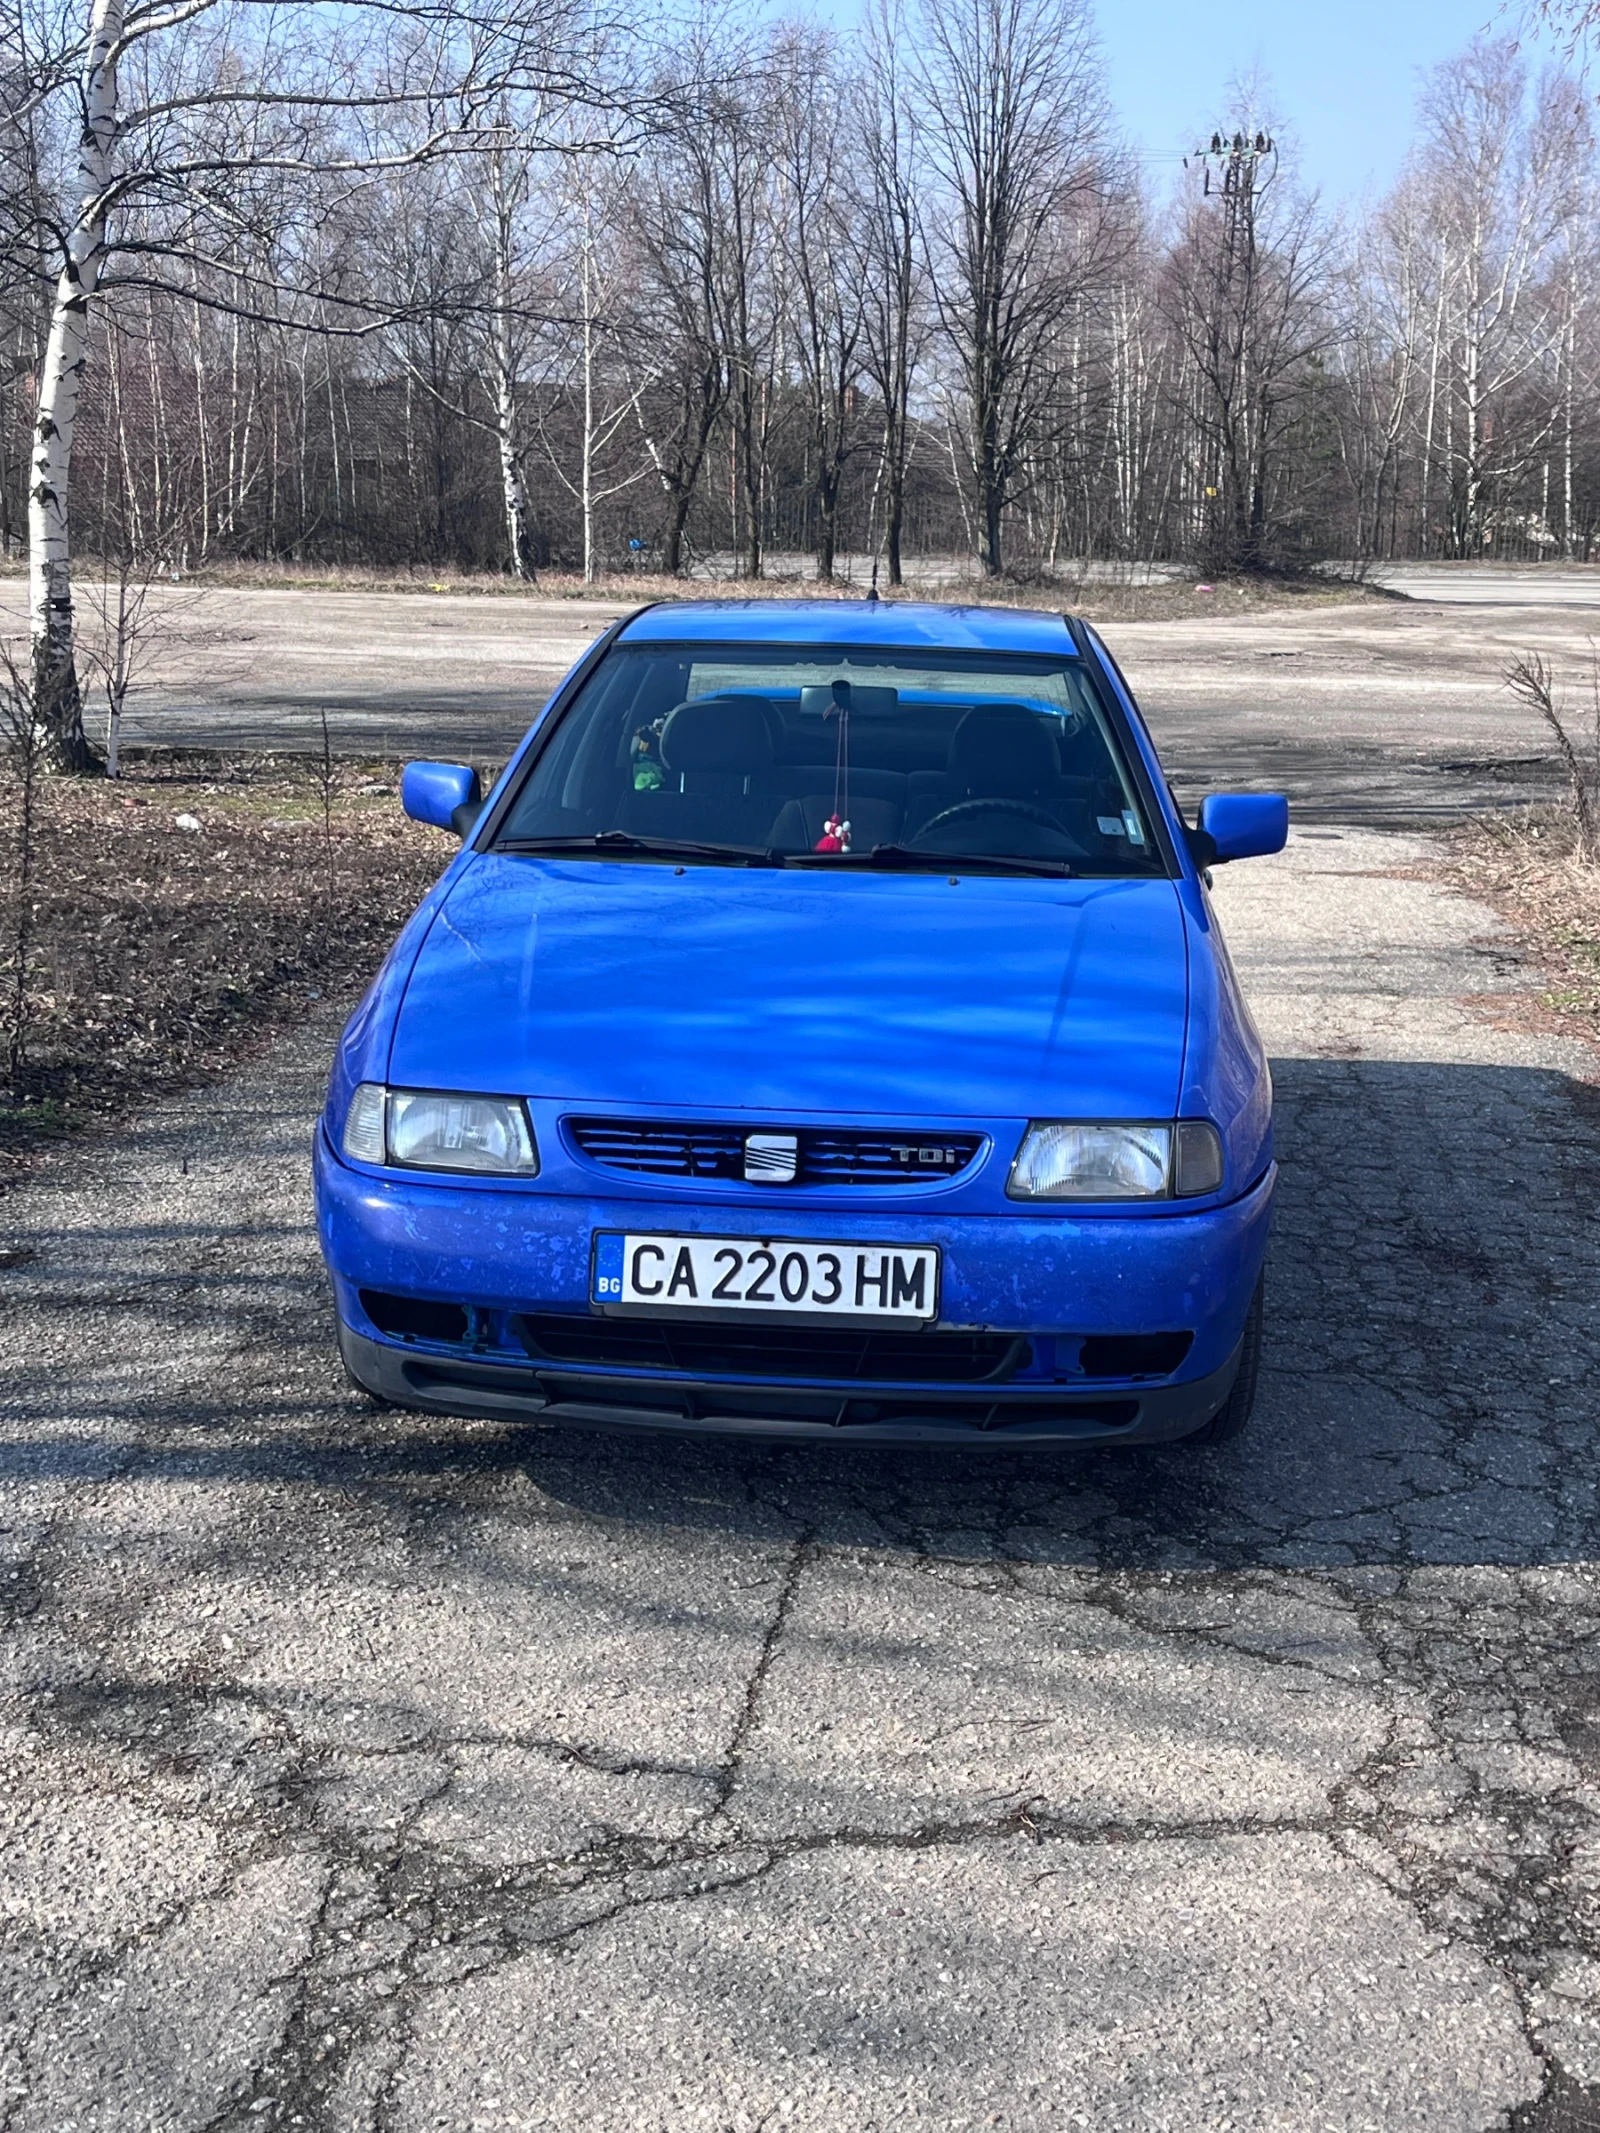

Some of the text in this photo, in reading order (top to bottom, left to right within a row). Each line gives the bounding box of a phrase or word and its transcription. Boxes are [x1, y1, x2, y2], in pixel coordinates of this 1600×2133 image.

[598, 1277, 621, 1293] BG
[631, 1244, 925, 1309] CA 2203 HM
